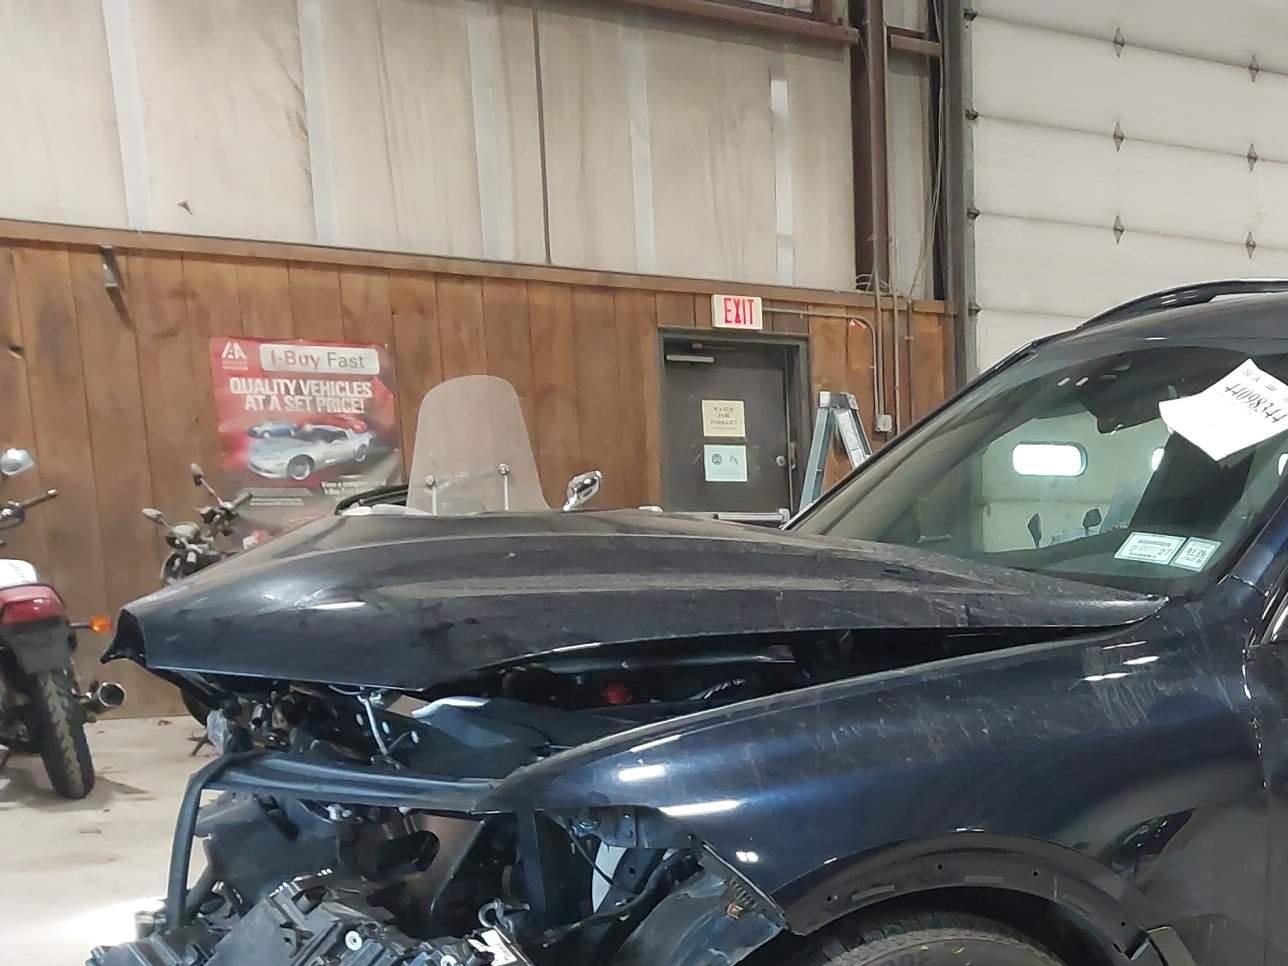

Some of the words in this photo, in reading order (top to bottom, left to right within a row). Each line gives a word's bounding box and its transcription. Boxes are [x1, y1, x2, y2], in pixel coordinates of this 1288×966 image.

[723, 298, 754, 324] EXIT
[271, 349, 320, 369] I-Buy
[327, 351, 365, 369] Fast
[229, 377, 297, 395] QUALITY
[299, 379, 373, 398] VEHICLES
[245, 395, 266, 411] AT
[269, 396, 282, 411] A
[283, 396, 314, 412] SET
[316, 397, 366, 414] PRICE!
